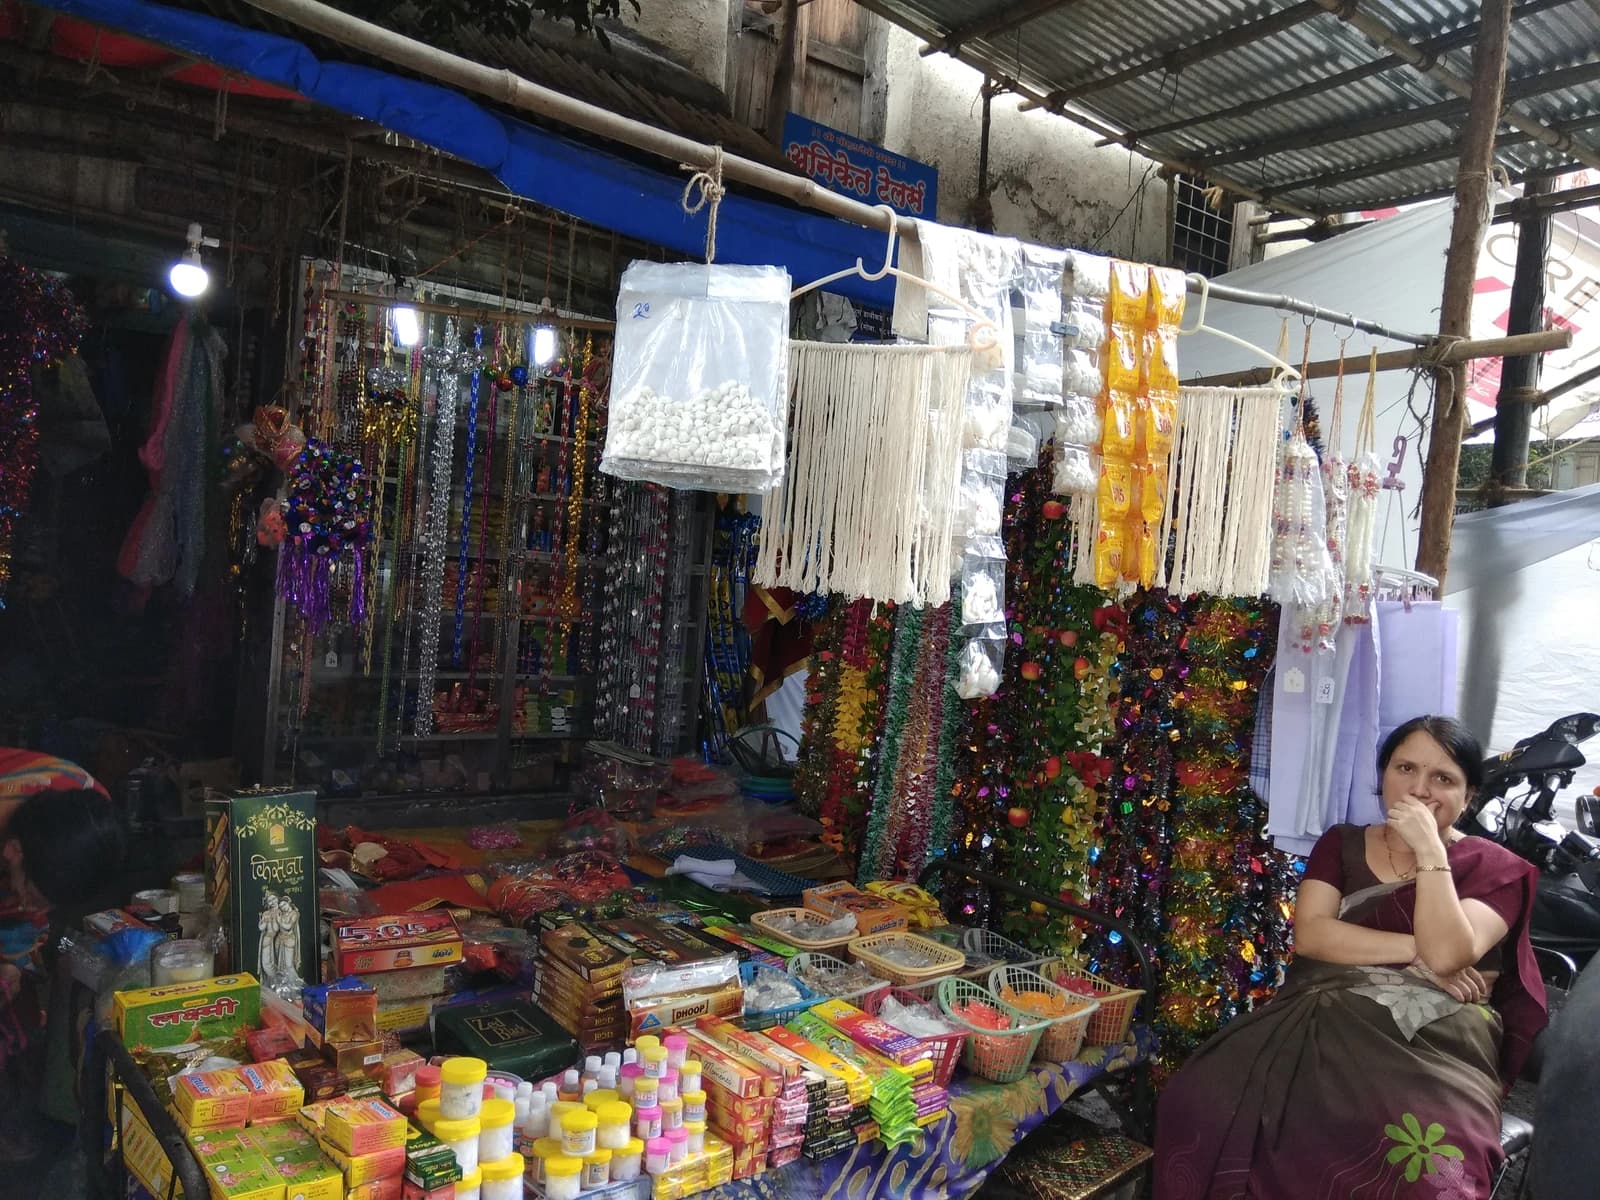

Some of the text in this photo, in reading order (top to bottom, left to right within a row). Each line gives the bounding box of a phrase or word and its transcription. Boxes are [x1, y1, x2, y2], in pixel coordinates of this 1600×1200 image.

[786, 140, 872, 196] अनिकेत
[876, 166, 926, 214] टेलर्स
[676, 1004, 705, 1020] DHOOP
